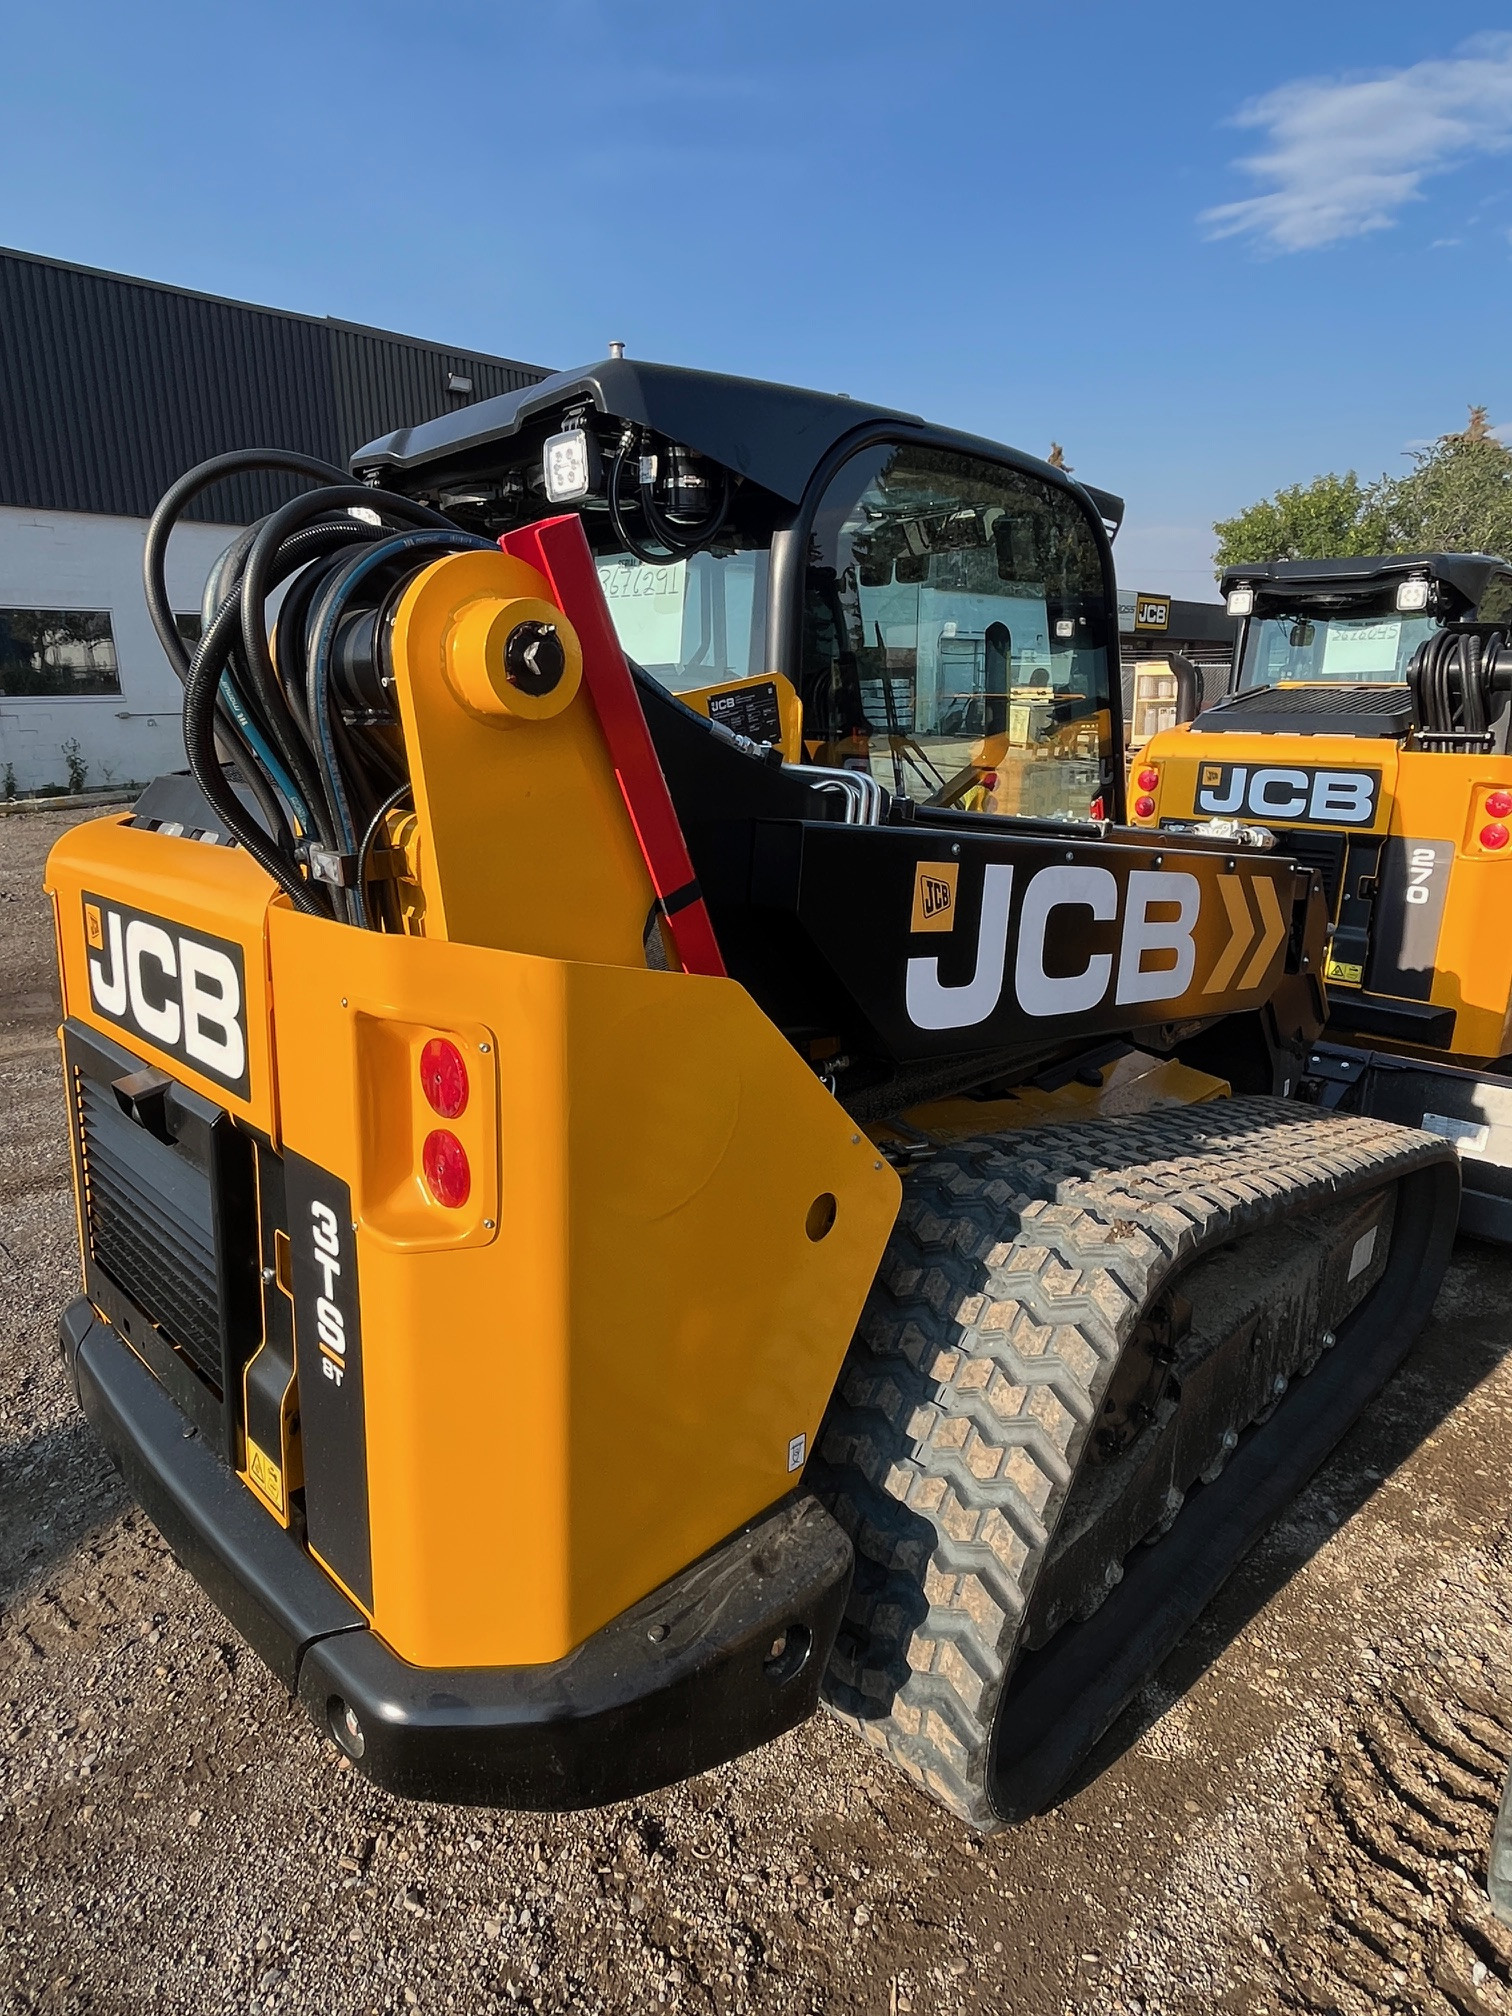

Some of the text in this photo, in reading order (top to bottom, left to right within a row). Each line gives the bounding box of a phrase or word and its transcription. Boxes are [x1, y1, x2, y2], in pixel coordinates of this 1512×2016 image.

[1138, 603, 1167, 624] JCB
[711, 697, 735, 712] JCB
[1200, 767, 1375, 822] JCB
[925, 880, 949, 913] JCB
[1406, 848, 1436, 904] 270
[906, 863, 1200, 1030] JCB
[90, 911, 245, 1080] JCB
[311, 1200, 346, 1387] 3TS 8T
